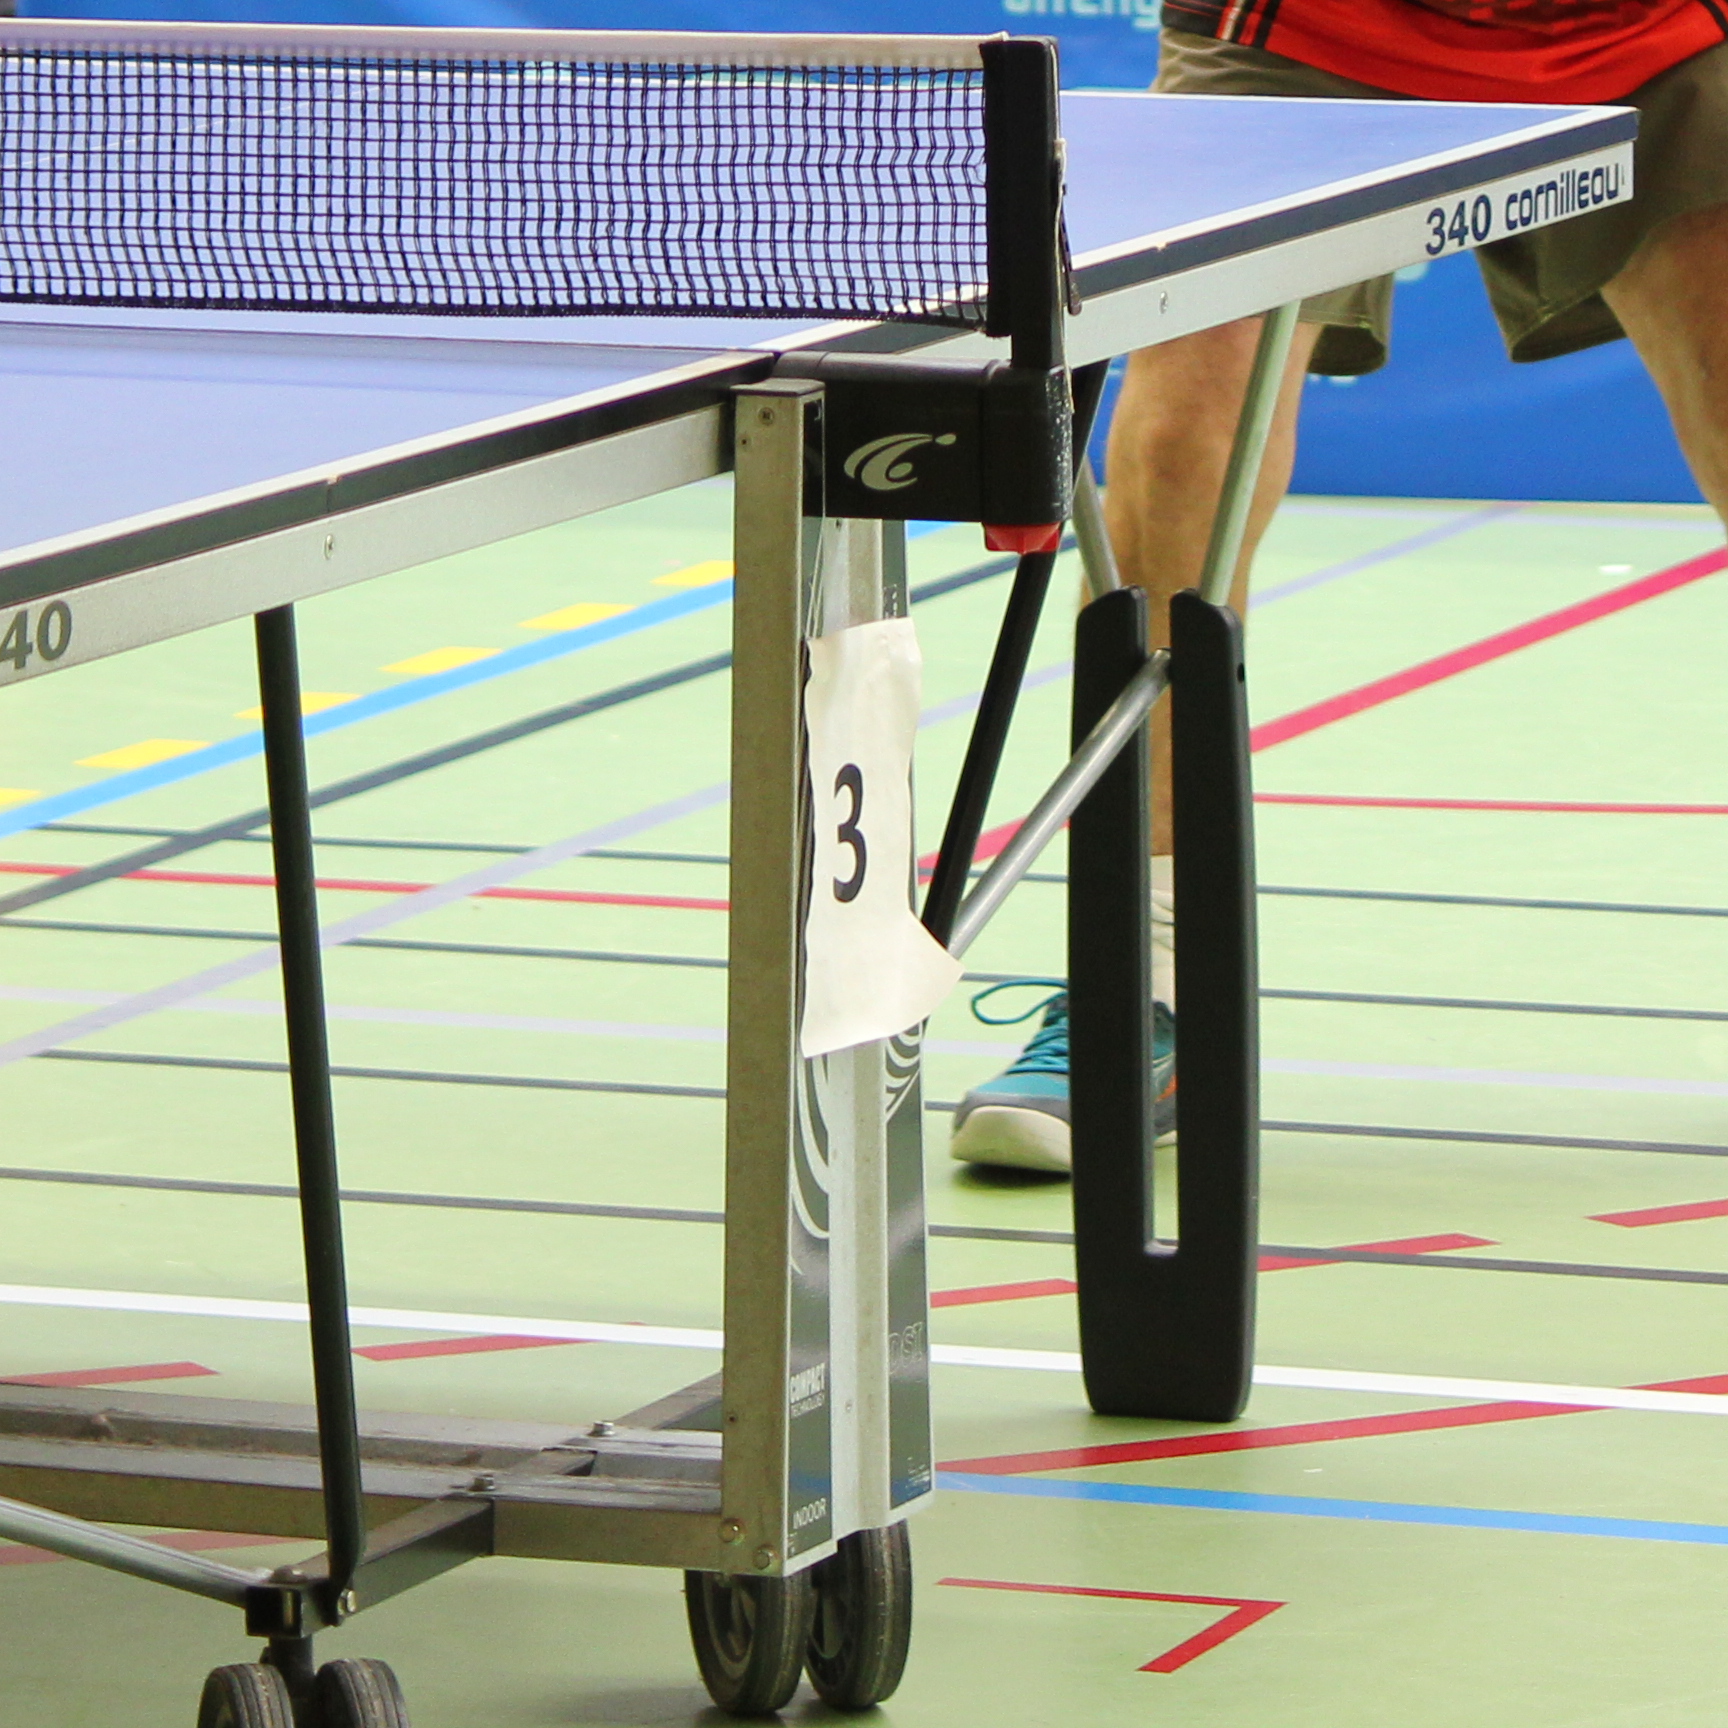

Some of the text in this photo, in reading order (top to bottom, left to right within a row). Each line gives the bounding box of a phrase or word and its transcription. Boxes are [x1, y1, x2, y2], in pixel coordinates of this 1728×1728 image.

[1424, 162, 1620, 257] 340 cornilleau
[832, 762, 868, 904] 3
[793, 1497, 827, 1530] INDOOR
